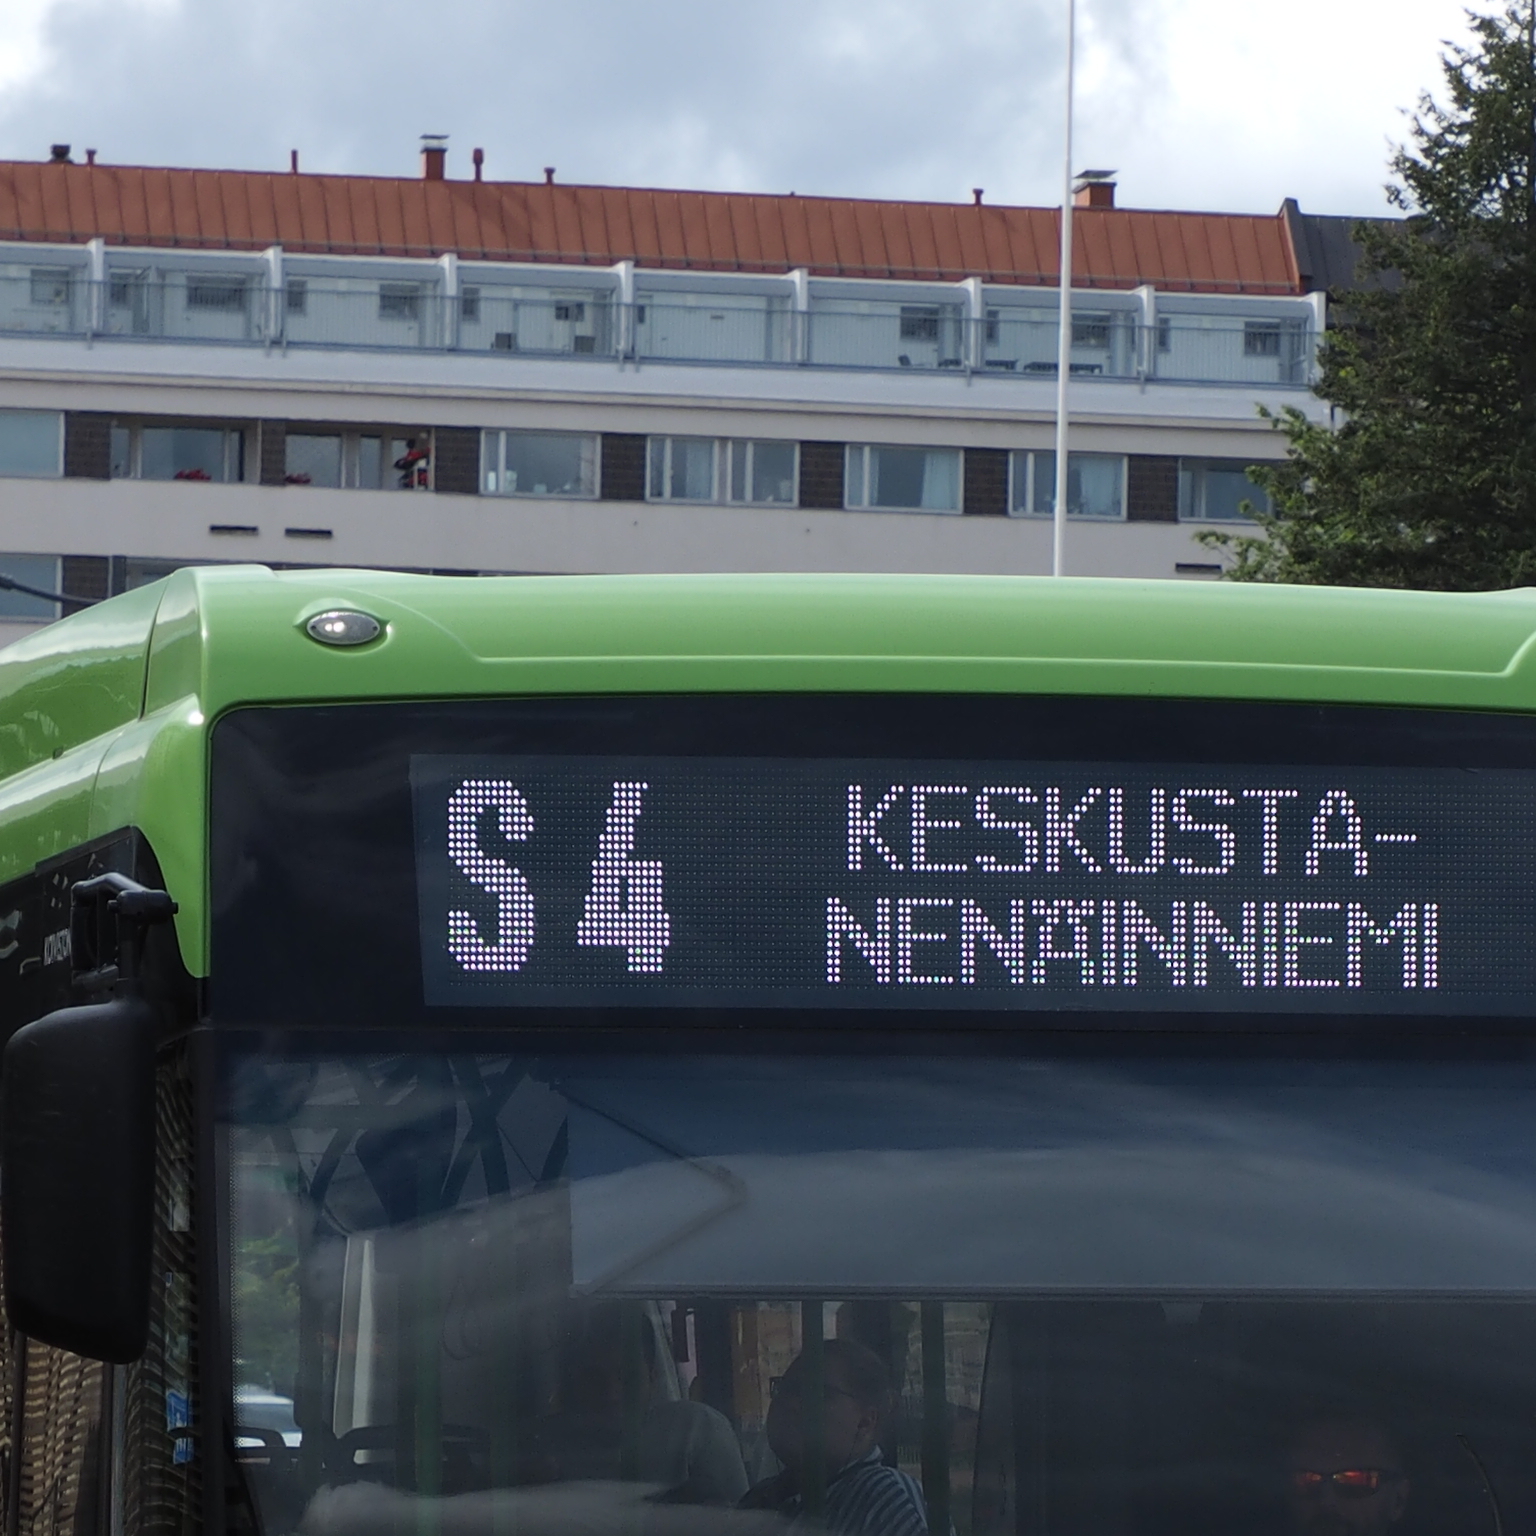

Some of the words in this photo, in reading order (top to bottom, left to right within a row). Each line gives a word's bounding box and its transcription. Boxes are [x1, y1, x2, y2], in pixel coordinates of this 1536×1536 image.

[448, 780, 534, 971] S
[577, 782, 670, 973] 4
[847, 784, 1418, 876] KESKUSTA-
[826, 896, 1439, 989] NENÄINNIEMI
